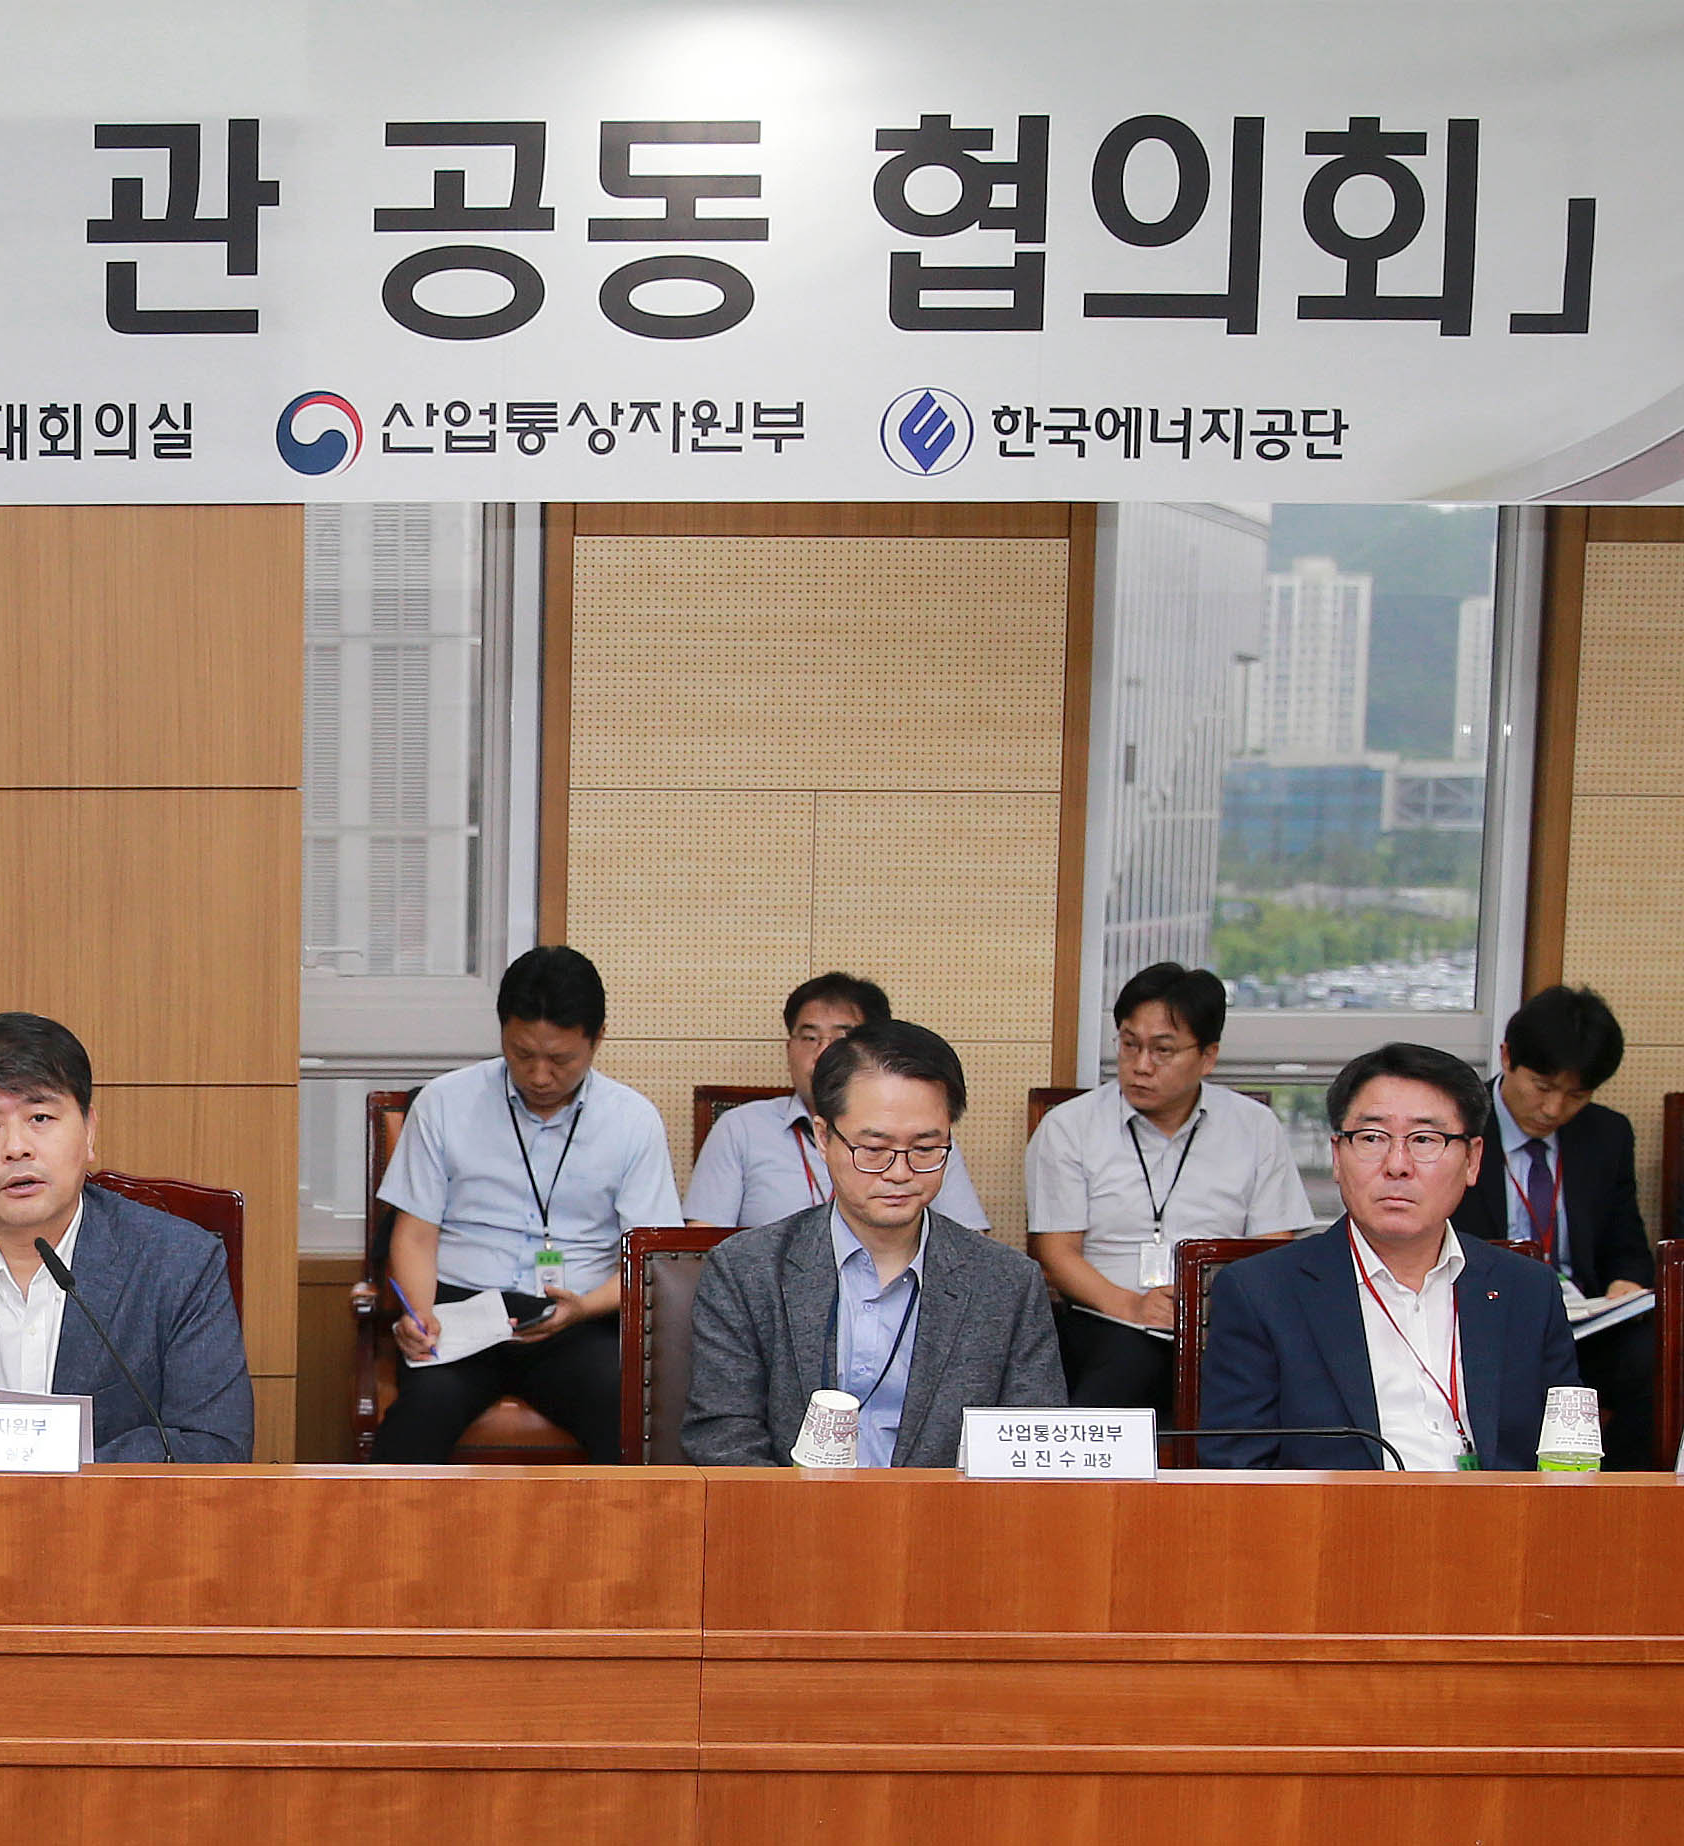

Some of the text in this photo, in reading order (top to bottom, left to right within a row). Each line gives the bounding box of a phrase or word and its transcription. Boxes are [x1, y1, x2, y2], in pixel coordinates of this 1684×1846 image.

[86, 118, 280, 335] 관
[373, 120, 769, 341] 공동
[382, 399, 805, 456] 산업통상자원부
[991, 405, 1350, 461] 한국에너지공단
[997, 1424, 1123, 1442] 산업통상자원부
[1083, 1453, 1113, 1468] 과장
